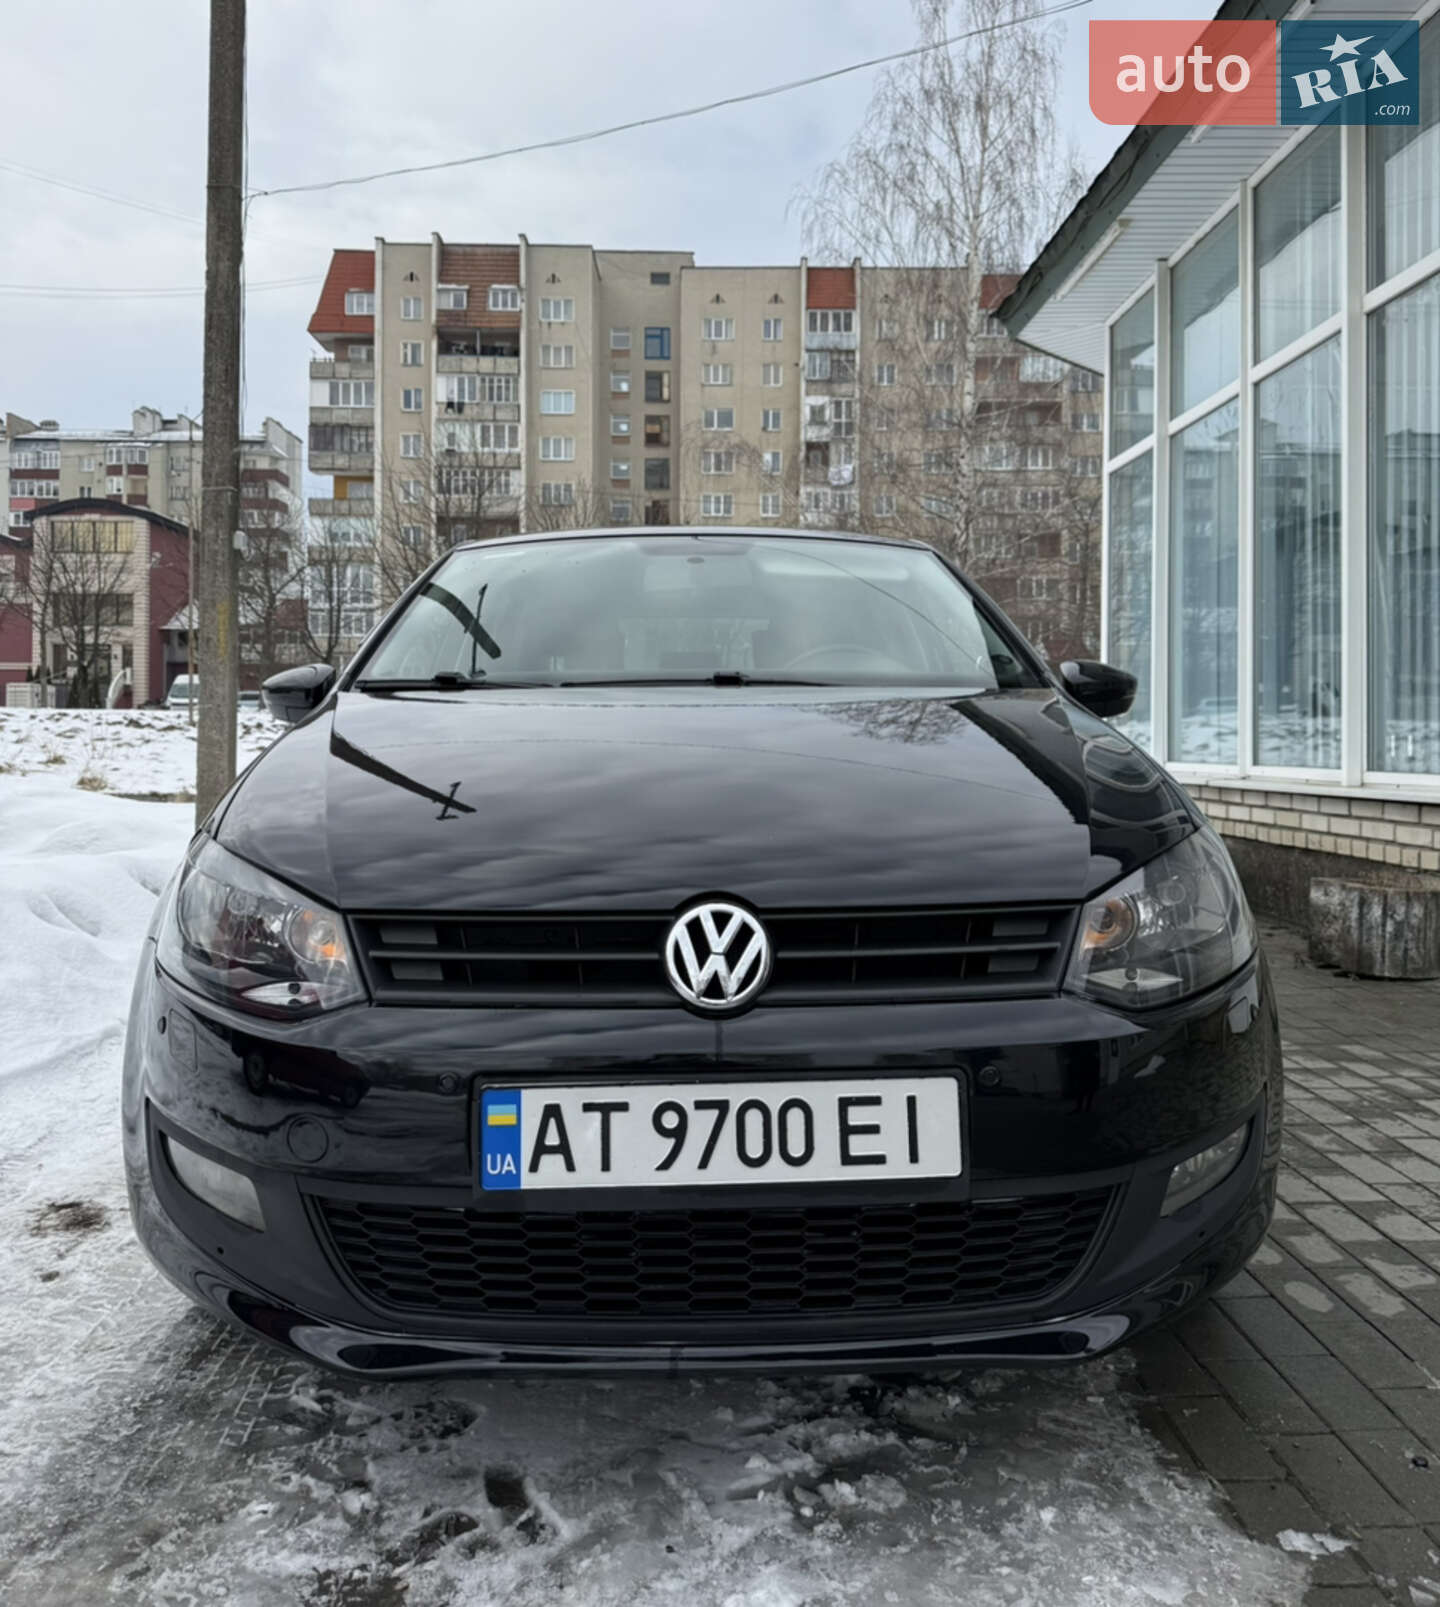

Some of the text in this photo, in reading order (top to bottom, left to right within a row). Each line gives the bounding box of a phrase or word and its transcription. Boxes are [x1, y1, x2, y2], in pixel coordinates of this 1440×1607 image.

[528, 1095, 919, 1173] AT 9700 EI
[486, 1153, 517, 1175] UA
